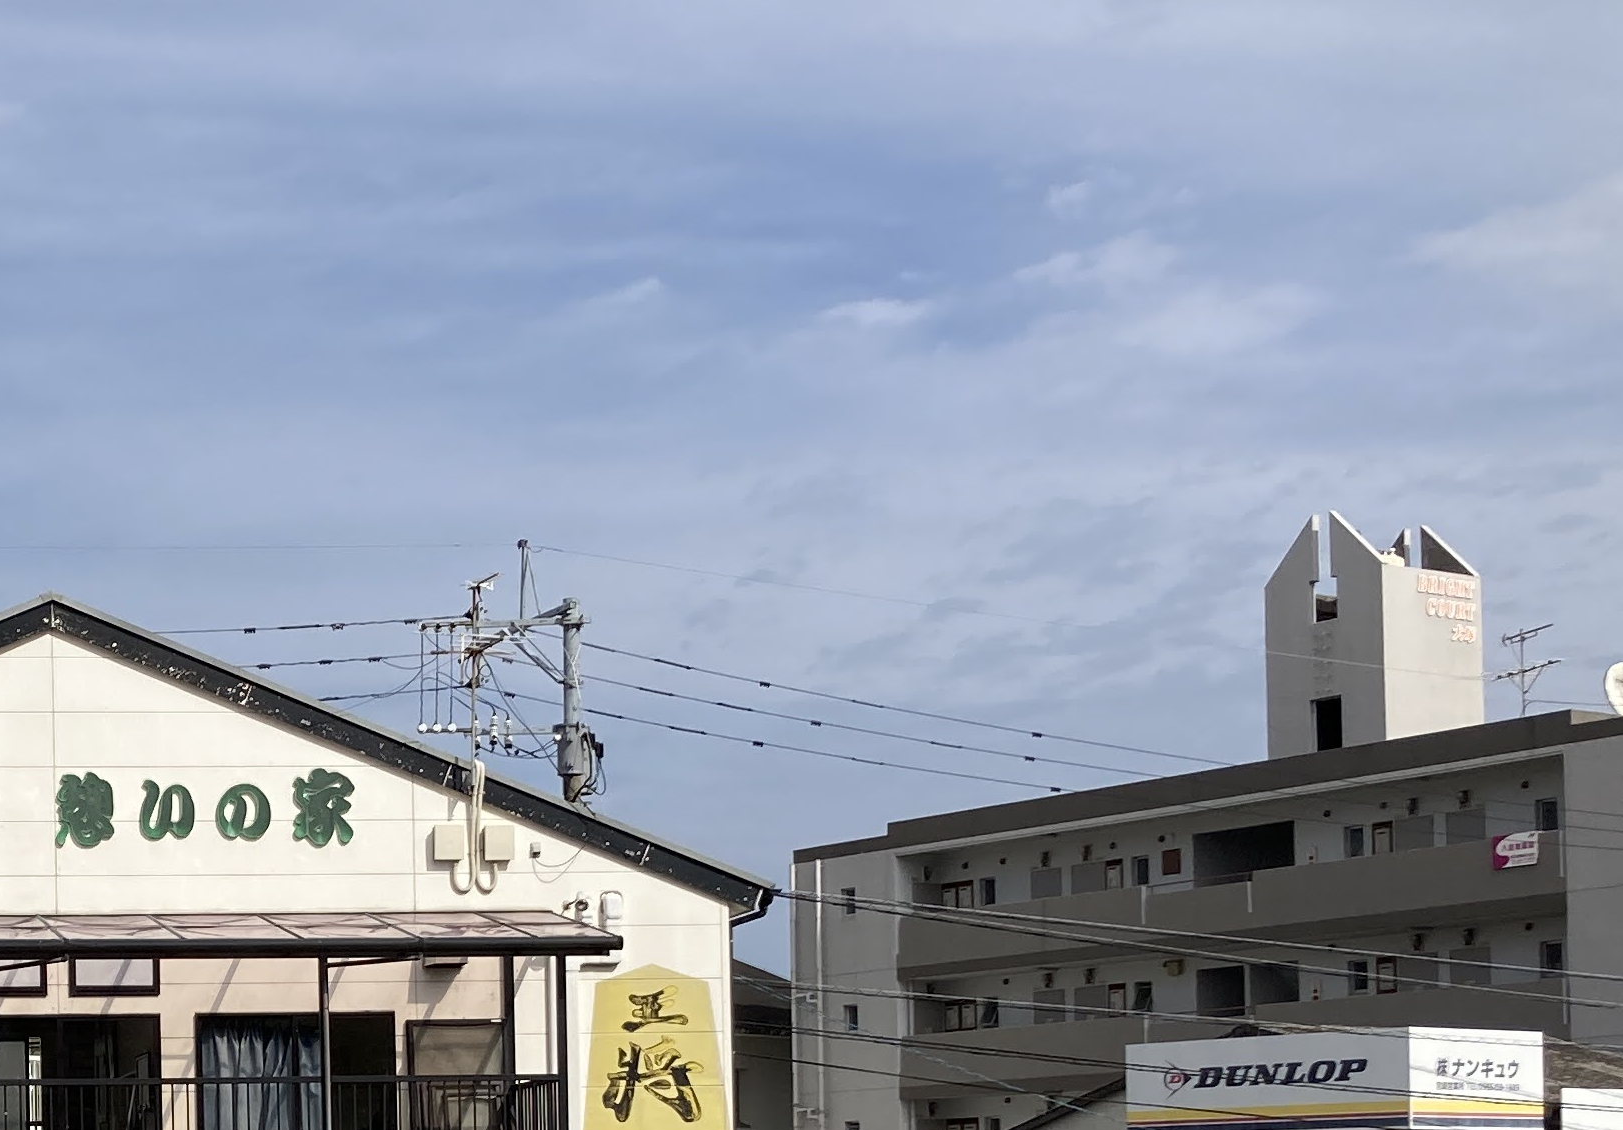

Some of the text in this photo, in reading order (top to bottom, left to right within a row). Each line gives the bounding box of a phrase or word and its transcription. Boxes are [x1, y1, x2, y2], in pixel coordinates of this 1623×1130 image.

[1417, 573, 1475, 599] BRIGHT
[1426, 597, 1476, 622] COURT
[55, 768, 355, 848] 憩いの家
[1193, 1058, 1369, 1089] DUNLOP
